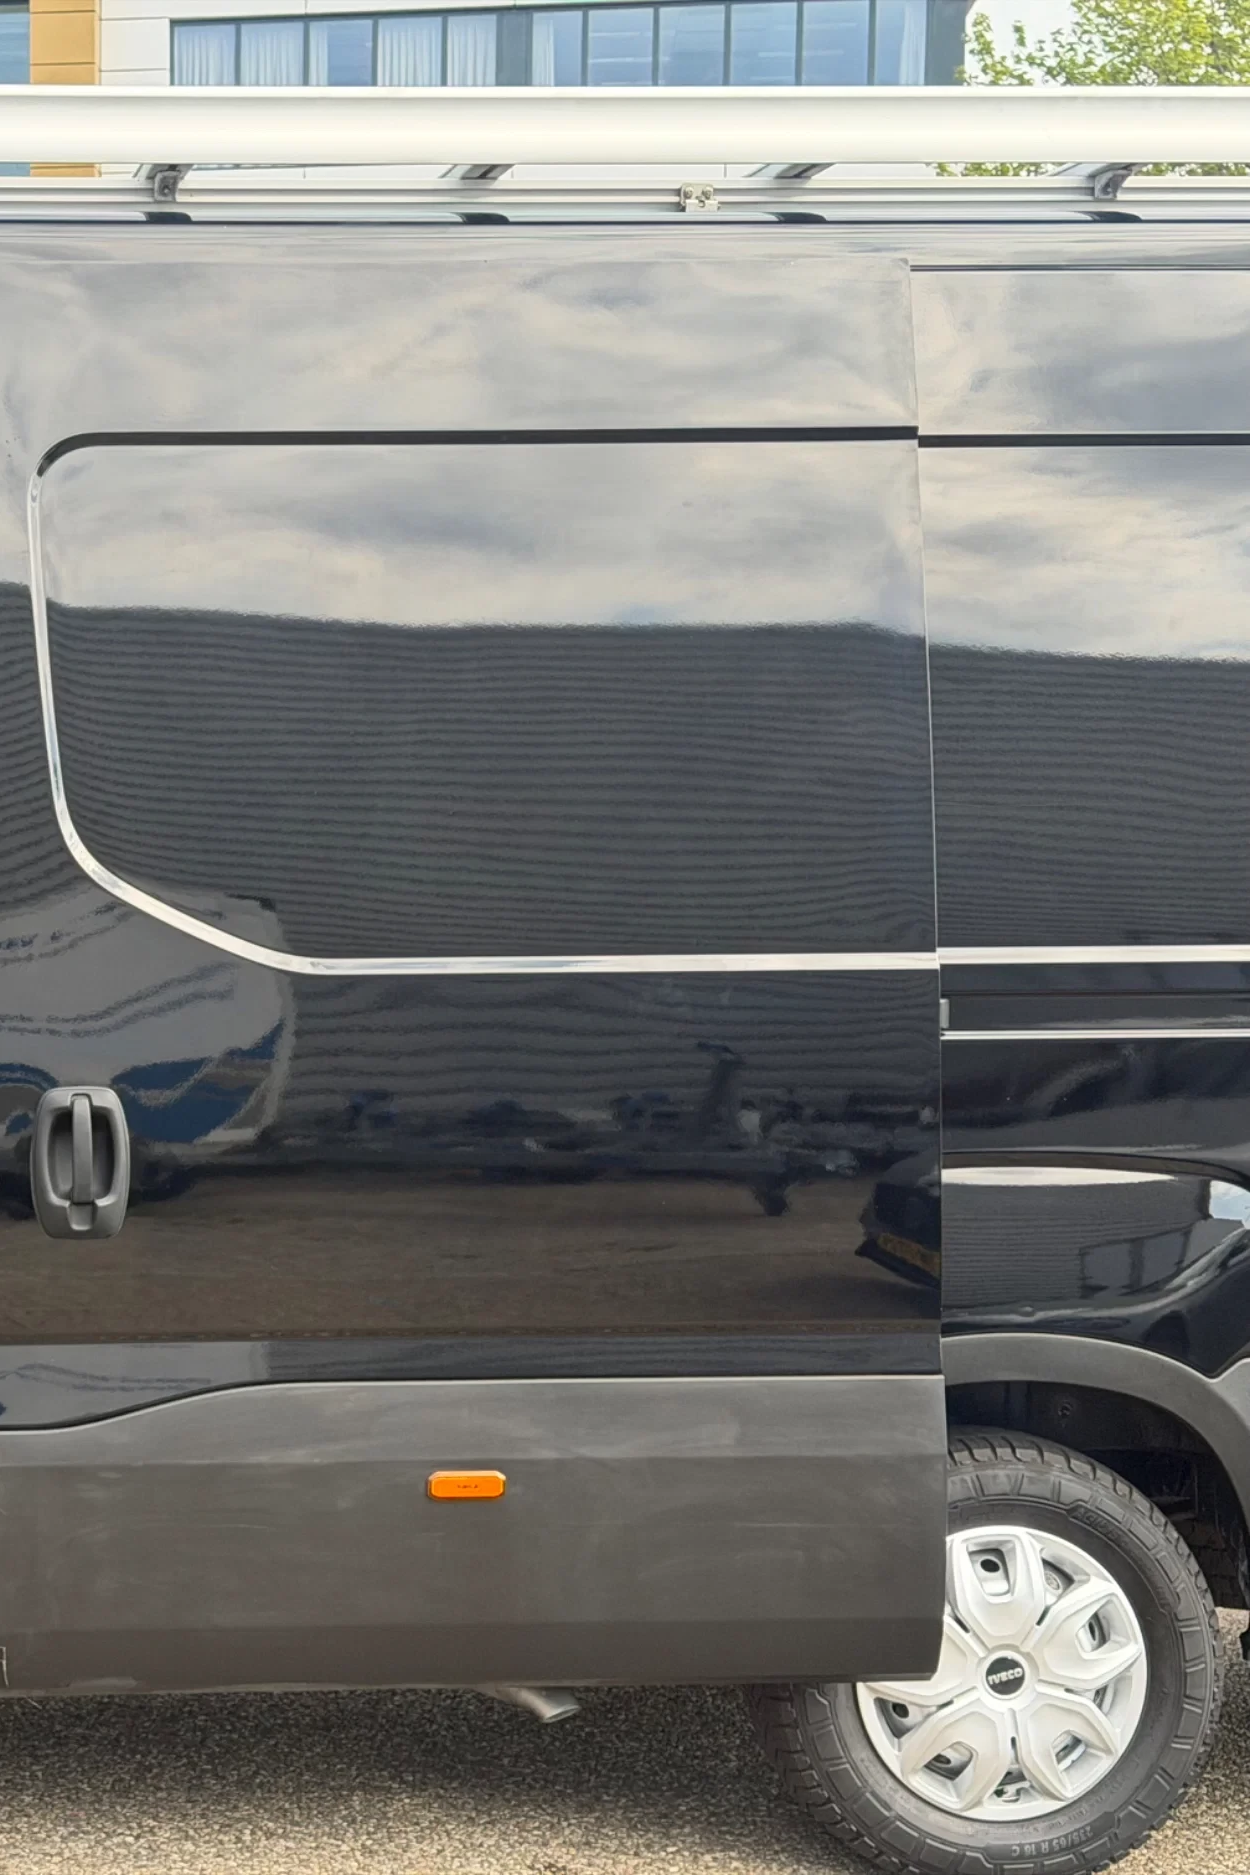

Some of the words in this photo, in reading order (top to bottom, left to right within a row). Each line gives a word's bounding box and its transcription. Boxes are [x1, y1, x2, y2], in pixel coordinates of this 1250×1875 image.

[987, 1667, 1023, 1685] IVECO
[1052, 1825, 1094, 1851] 235/65
[1011, 1845, 1020, 1857] C
[1024, 1843, 1036, 1856] 16
[1040, 1841, 1049, 1854] R
